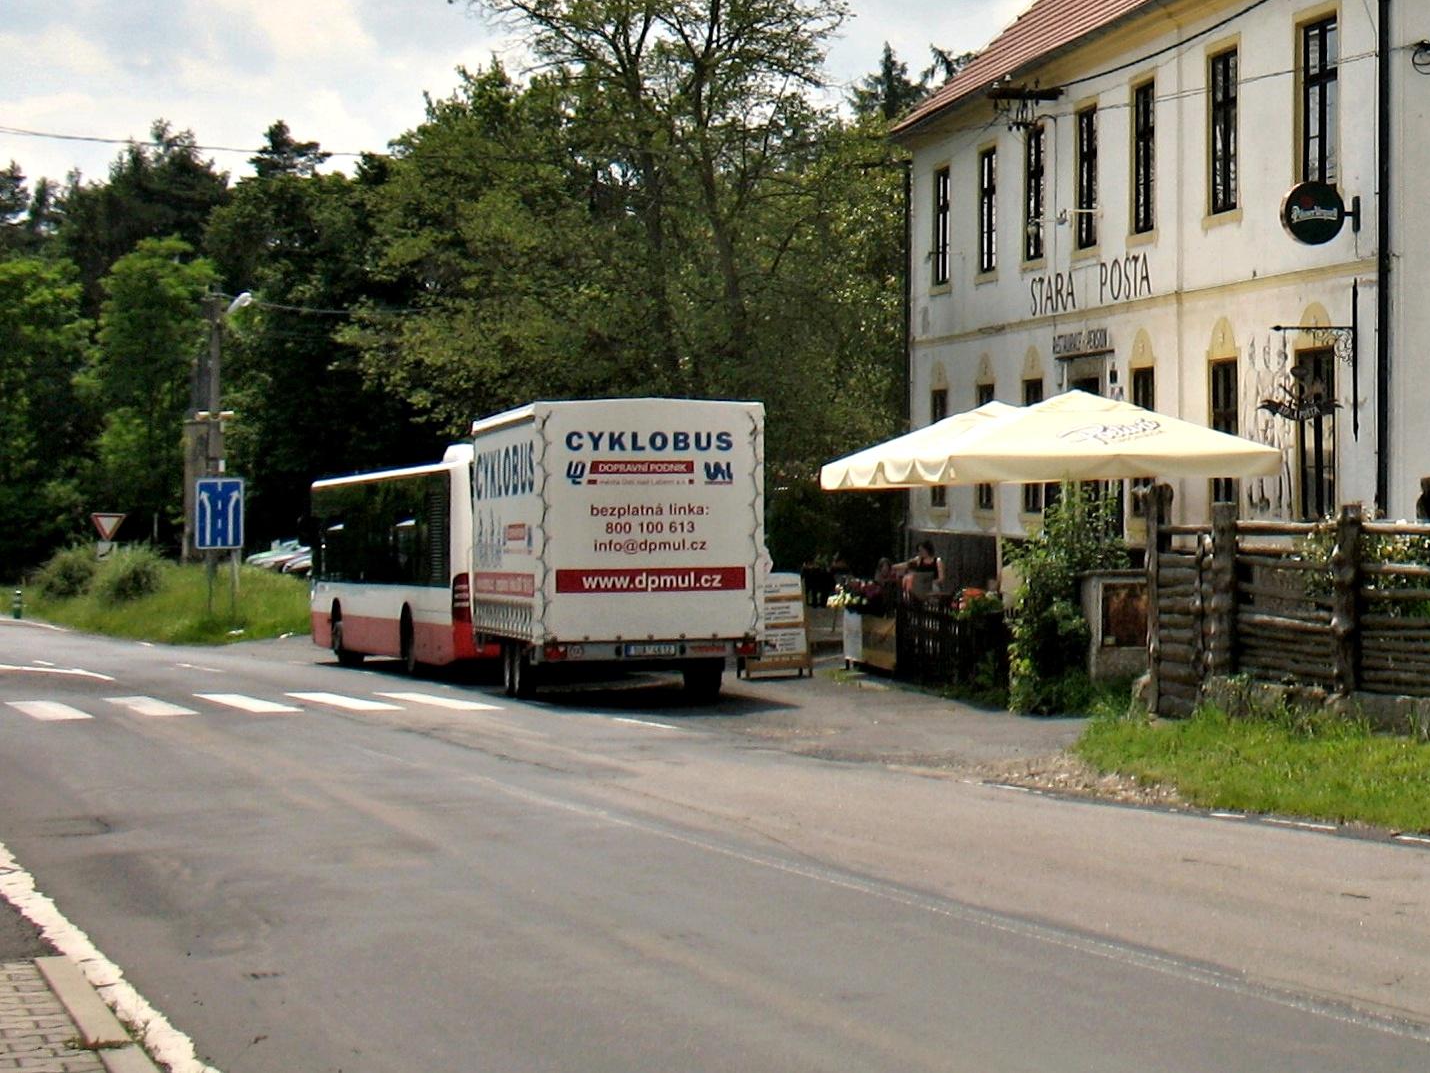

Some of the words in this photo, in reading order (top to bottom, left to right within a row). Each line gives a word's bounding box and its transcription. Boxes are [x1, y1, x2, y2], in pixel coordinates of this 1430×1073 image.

[565, 431, 733, 451] CYKLOBUS
[475, 440, 534, 500] CYKLOBUS
[599, 462, 648, 473] DOPRAVNÍ
[650, 462, 687, 472] PODNIK
[590, 504, 663, 518] bezplatná
[669, 503, 709, 515] linka:
[605, 522, 632, 534] 800
[639, 521, 664, 533] 100
[669, 521, 695, 533] 613
[594, 538, 707, 555] info@dpmul.cz
[582, 571, 722, 592] www.dpmul.cz
